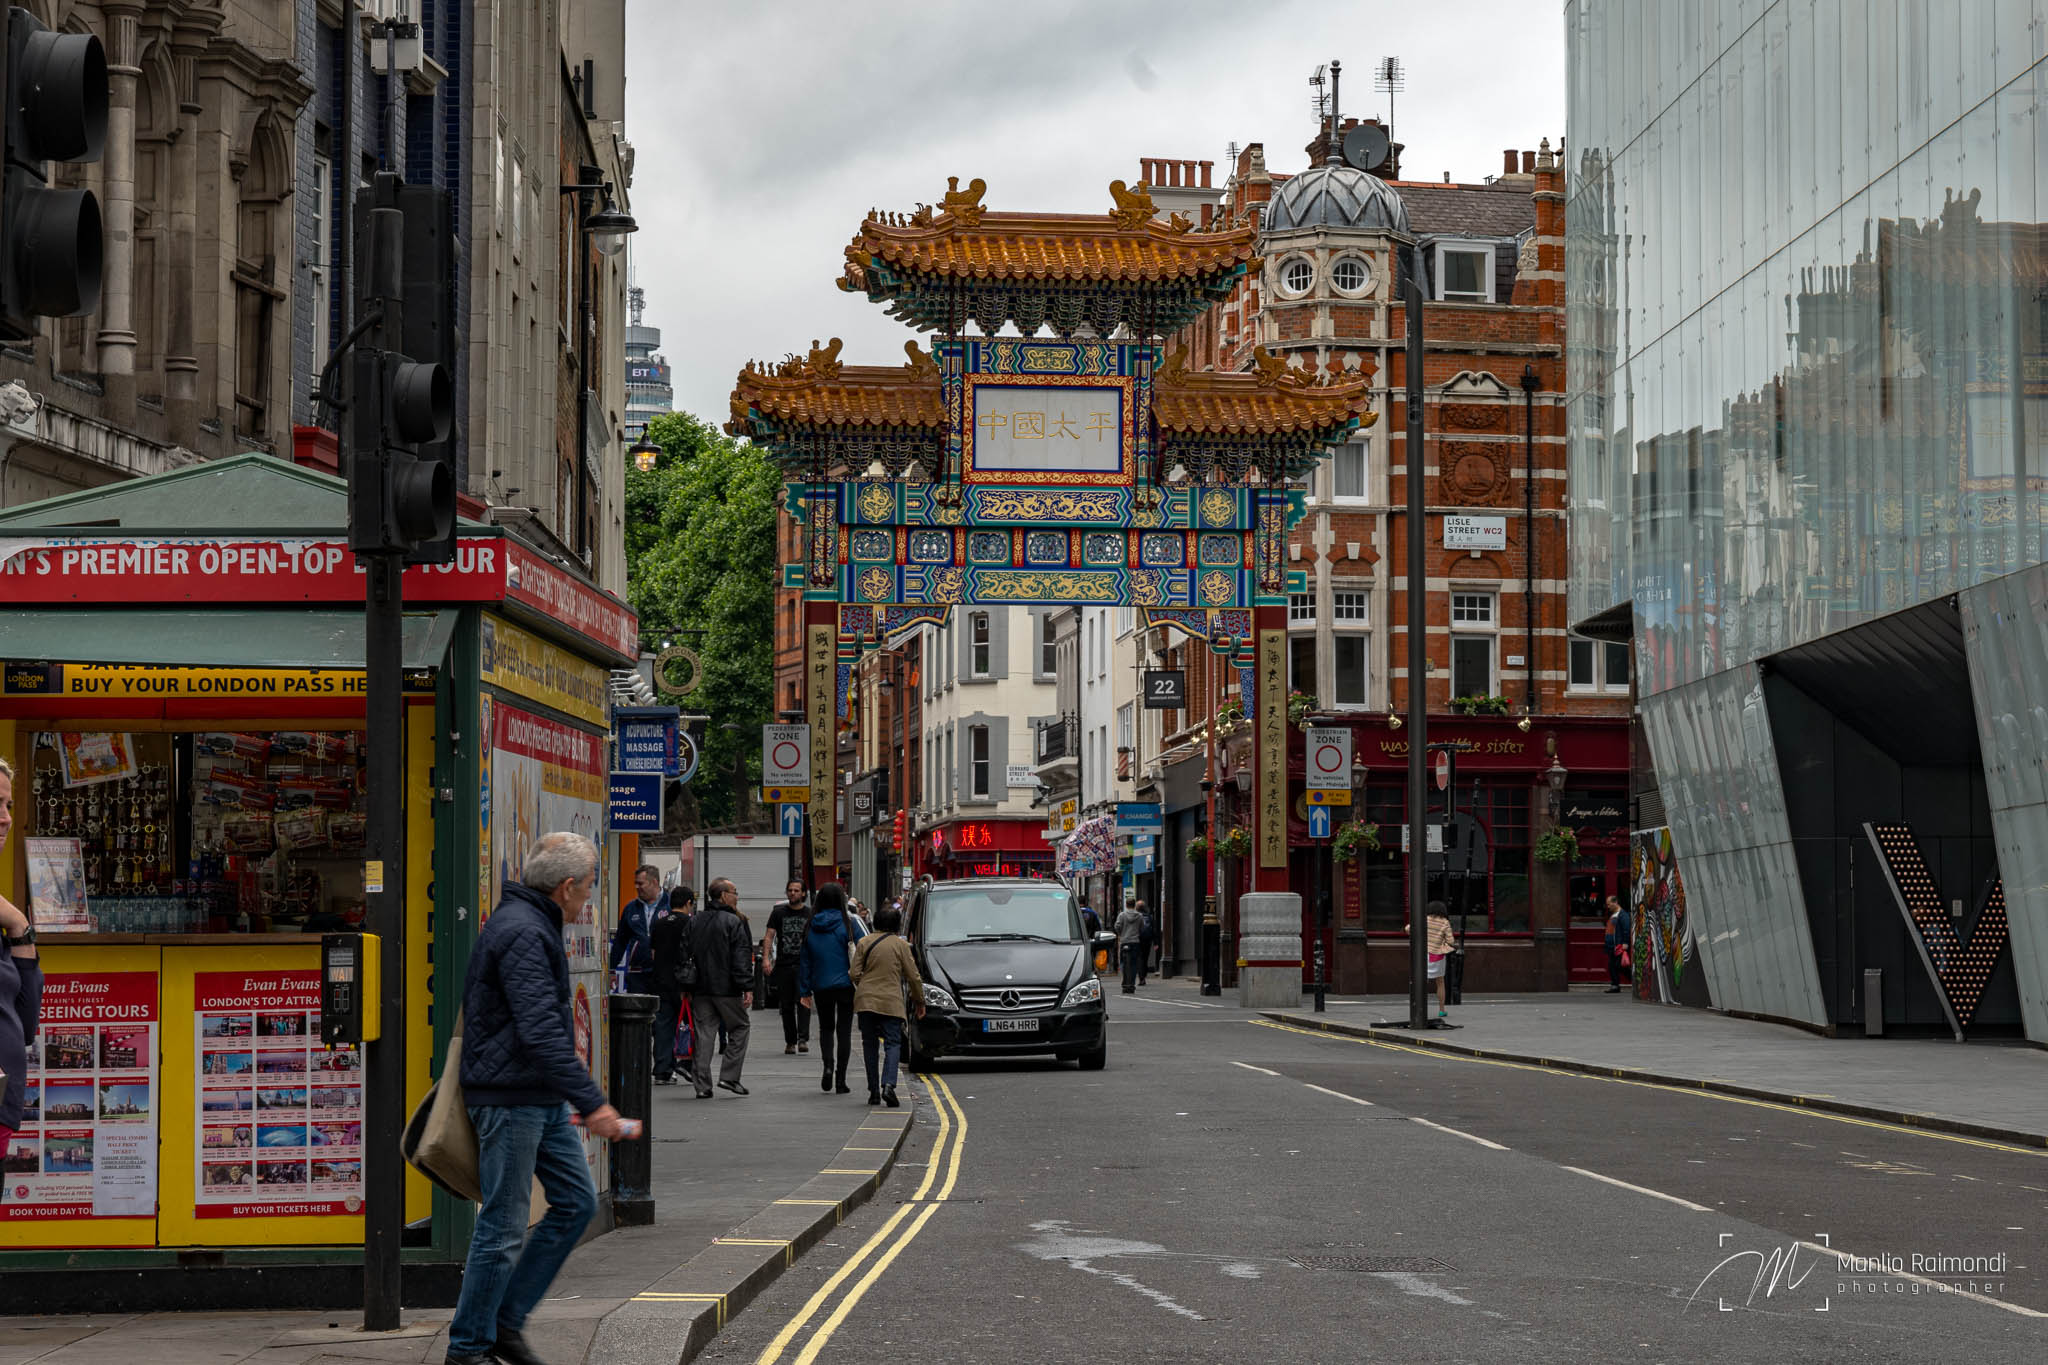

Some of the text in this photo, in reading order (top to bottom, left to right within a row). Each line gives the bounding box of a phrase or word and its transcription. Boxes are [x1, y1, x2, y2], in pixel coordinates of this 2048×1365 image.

[632, 368, 649, 376] BT
[978, 408, 1117, 442] 中國太平
[1447, 518, 1471, 526] LISLE
[1447, 526, 1502, 535] STREET WC2
[0, 548, 52, 576] N'S
[62, 547, 190, 575] PREMIER
[199, 547, 344, 575] OPEN-TOP
[8, 675, 45, 683] LONDON
[18, 681, 37, 689] PASS
[71, 677, 368, 693] BUY YOUR LONDON PASS HE
[1154, 680, 1175, 694] 22
[626, 724, 664, 738] ACUPUNCTURE
[772, 732, 800, 741] ZONE
[1316, 736, 1342, 744] ZONE
[626, 743, 664, 752] MASSAGE
[1486, 738, 1525, 753] sister
[610, 786, 636, 796] ssage
[609, 799, 647, 809] uncture
[614, 812, 657, 821] Medicine
[960, 823, 992, 847] 娱乐
[43, 980, 110, 994] van Evans
[243, 977, 321, 992] Evan Evans
[202, 995, 321, 1007] LONDON'S TOP ATTRA
[38, 1004, 149, 1019] SEEING TOURS
[990, 1020, 1037, 1030] LN64 HRR
[9, 1208, 34, 1216] BOOK
[34, 1207, 59, 1216] YOUR
[60, 1207, 76, 1215] DAY
[233, 1204, 332, 1214] BUY YOUR TICKETS HERE
